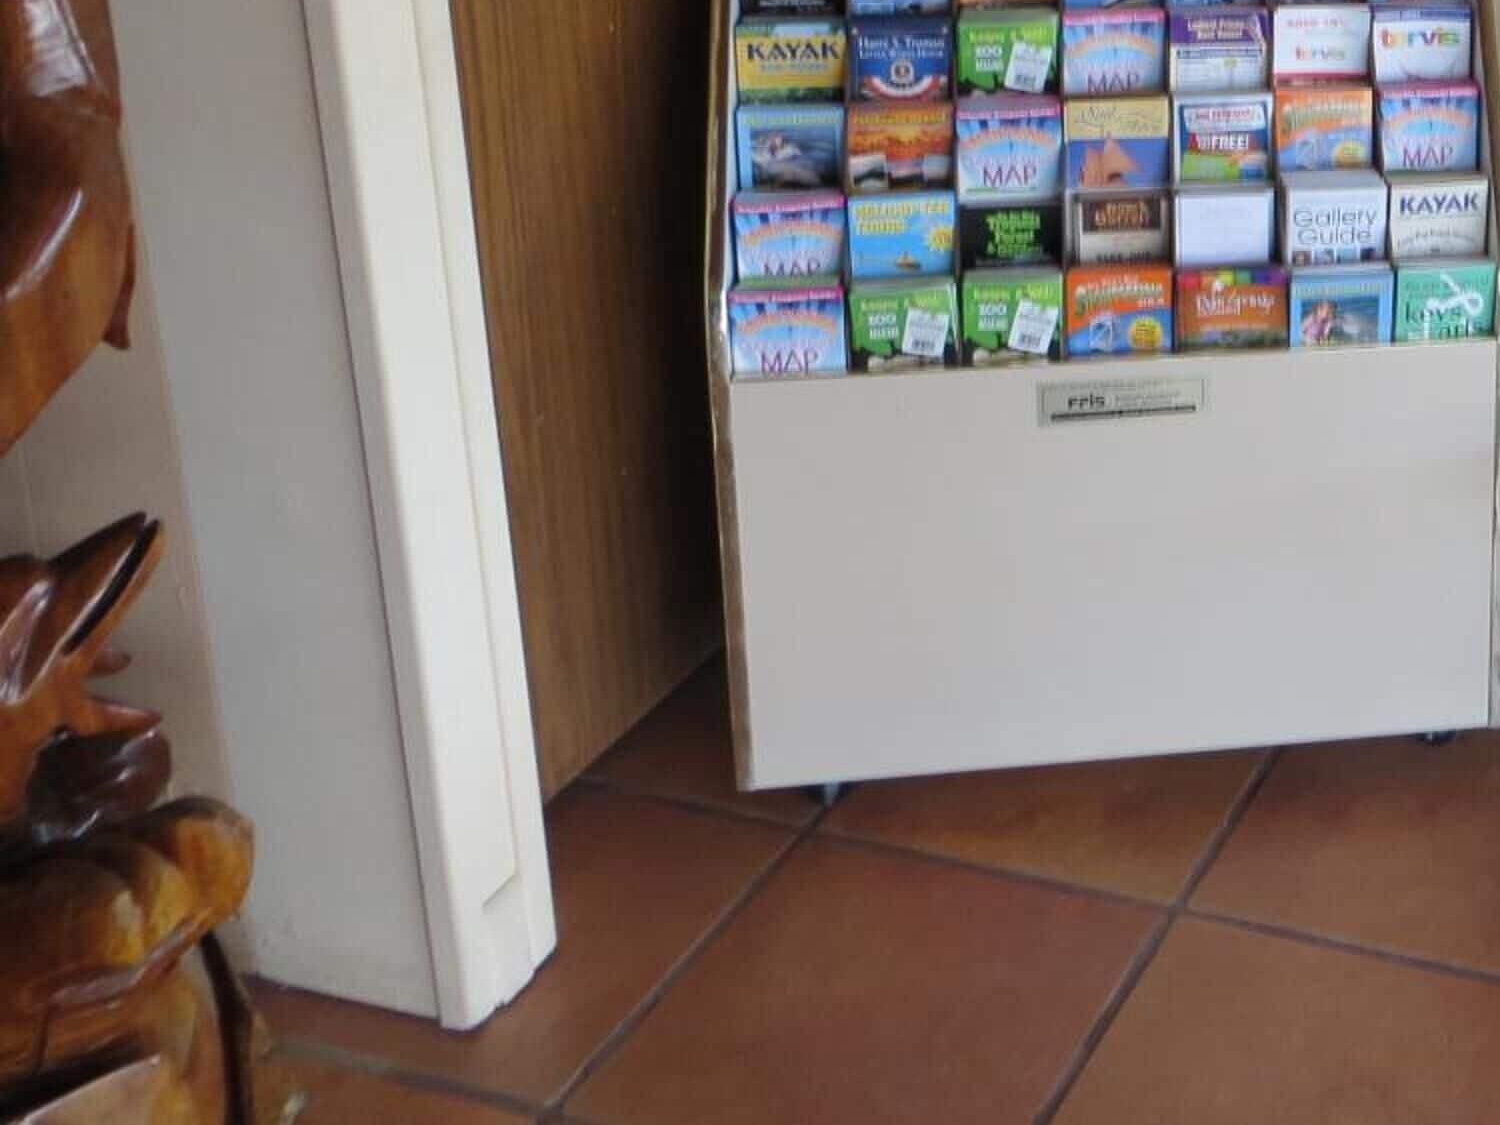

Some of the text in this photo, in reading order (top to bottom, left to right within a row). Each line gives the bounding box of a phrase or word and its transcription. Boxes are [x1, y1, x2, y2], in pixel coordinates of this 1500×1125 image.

[747, 40, 841, 61] KAYAK
[1087, 71, 1140, 94] MAP
[1402, 145, 1454, 168] MAP
[982, 164, 1039, 187] MAP
[1399, 192, 1480, 217] KAYAK
[1293, 206, 1377, 230] Gallery
[1297, 227, 1371, 245] Guide
[763, 259, 823, 277] MAP
[759, 349, 820, 375] MAP
